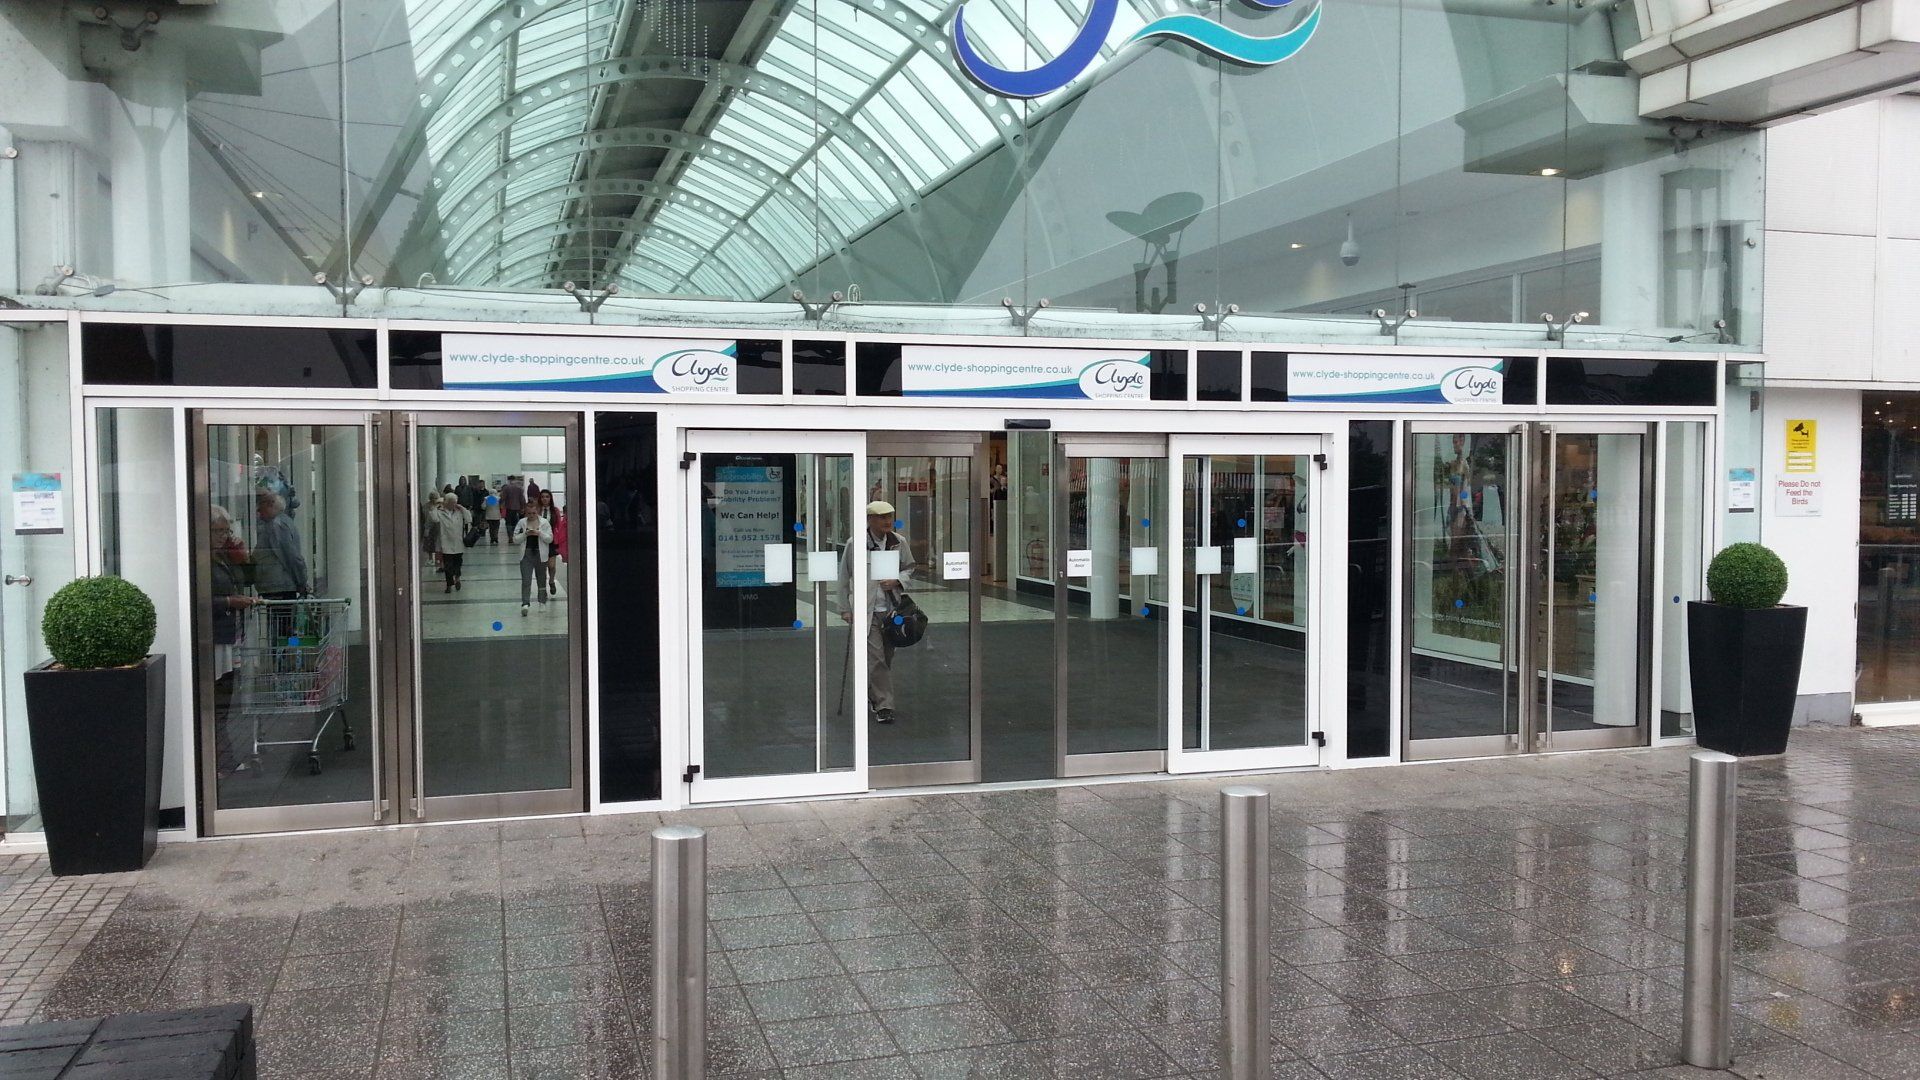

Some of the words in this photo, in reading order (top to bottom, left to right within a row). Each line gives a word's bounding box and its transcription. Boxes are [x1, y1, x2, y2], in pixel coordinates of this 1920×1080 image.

[449, 351, 645, 367] www.clyde-shoppingcentre.co.uk
[671, 353, 728, 385] Clyde
[907, 362, 1073, 376] www.clyde-shoppingcentre.co.uk
[1292, 369, 1435, 381] www.clyde-shoppingcentre.co.uk
[1095, 362, 1144, 392] Clyde
[1455, 369, 1497, 396] Clyde
[672, 385, 705, 393] SHOPPING
[1778, 480, 1799, 488] Please
[1800, 480, 1810, 488] Do
[1811, 480, 1821, 488] not
[1791, 497, 1808, 505] Birds
[720, 511, 735, 519] We
[737, 511, 754, 519] Can
[756, 511, 780, 520] Help!
[718, 534, 738, 542] 0141
